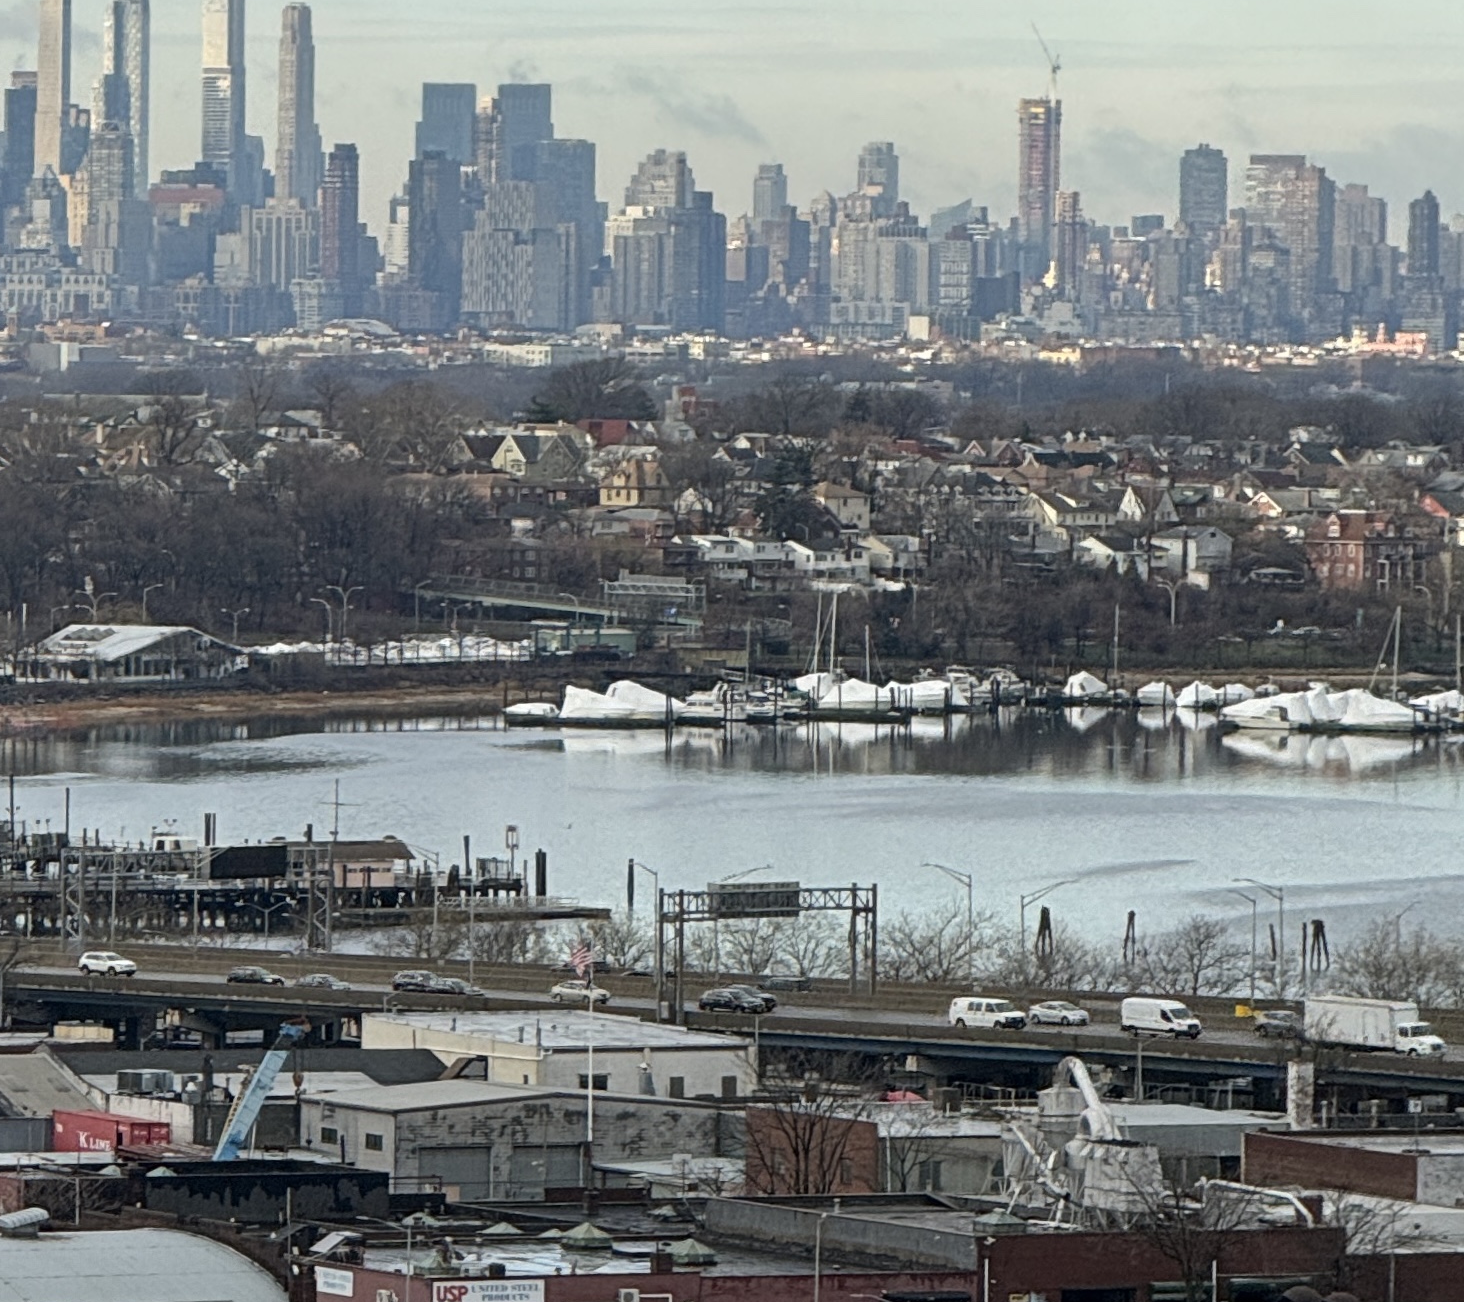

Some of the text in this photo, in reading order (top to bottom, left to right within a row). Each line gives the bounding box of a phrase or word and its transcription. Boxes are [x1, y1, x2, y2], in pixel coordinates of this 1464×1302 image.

[76, 1131, 112, 1152] K LINE
[471, 1283, 539, 1294] UNITED STEEL
[481, 1293, 530, 1302] PRODUCTS
